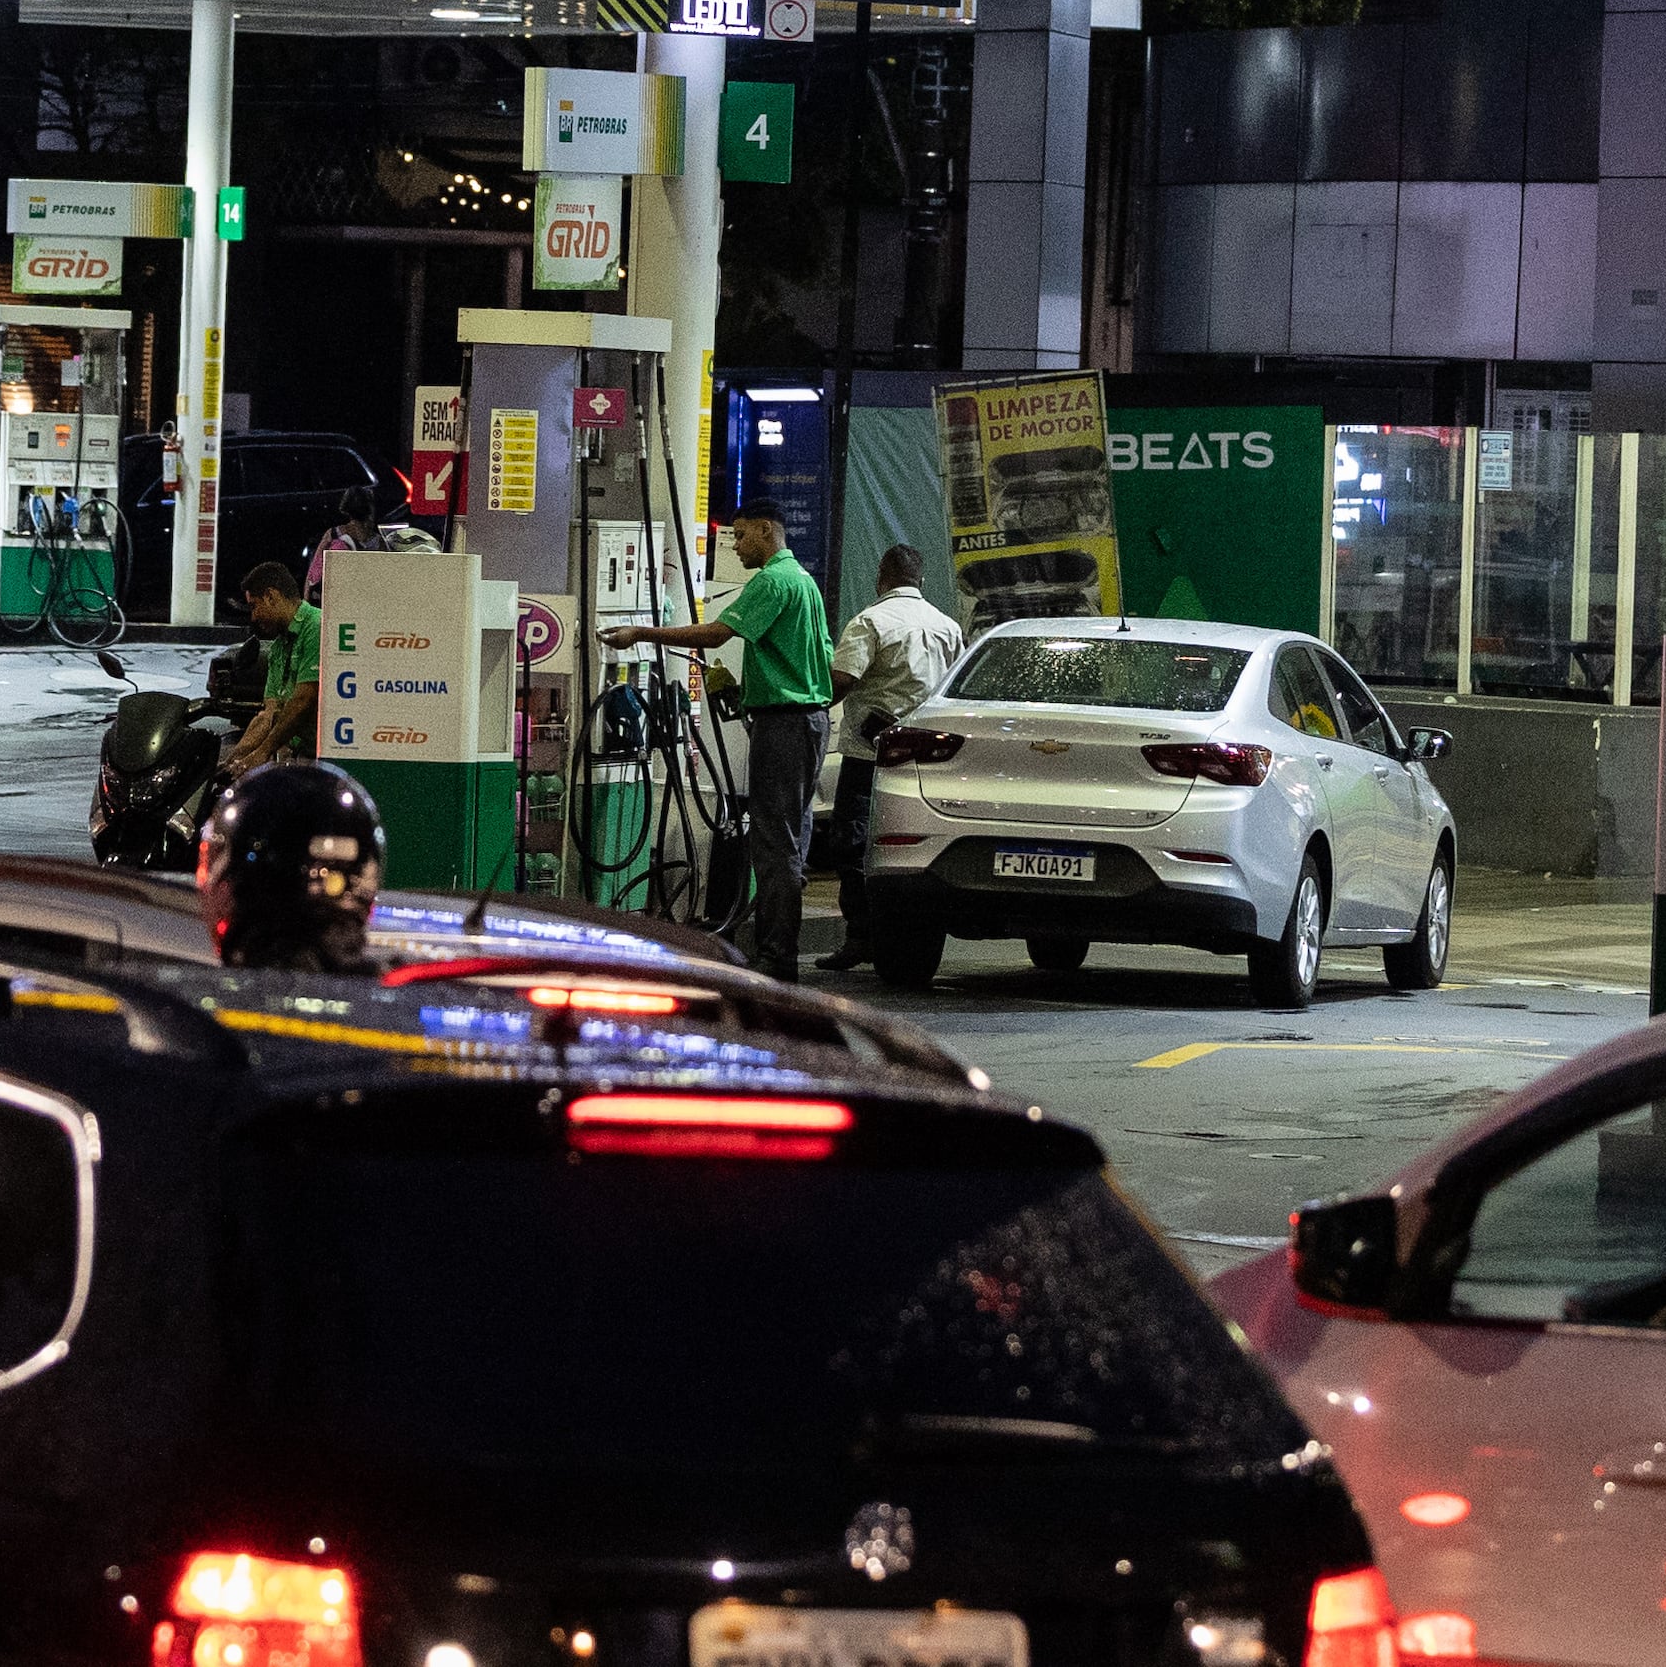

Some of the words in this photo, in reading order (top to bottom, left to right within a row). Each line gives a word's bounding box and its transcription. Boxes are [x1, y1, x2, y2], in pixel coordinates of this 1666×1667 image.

[577, 115, 627, 135] PETROBRAS
[745, 113, 770, 150] 4
[52, 204, 116, 216] PETROBRAS
[222, 202, 240, 223] 14
[555, 203, 585, 214] PETROBRAS
[546, 220, 610, 259] GRID
[27, 257, 109, 279] GRID
[423, 401, 448, 421] SEM
[985, 389, 1093, 421] LIMPEZA
[989, 423, 1017, 442] DE
[1020, 415, 1094, 439] MOTOR
[1108, 431, 1274, 471] BEATS
[958, 533, 1006, 551] ANTES
[338, 623, 356, 652] E
[374, 634, 431, 650] GRID
[336, 671, 357, 699] G
[374, 680, 448, 695] GASOLINA
[334, 717, 354, 745] G
[371, 728, 429, 744] GRID
